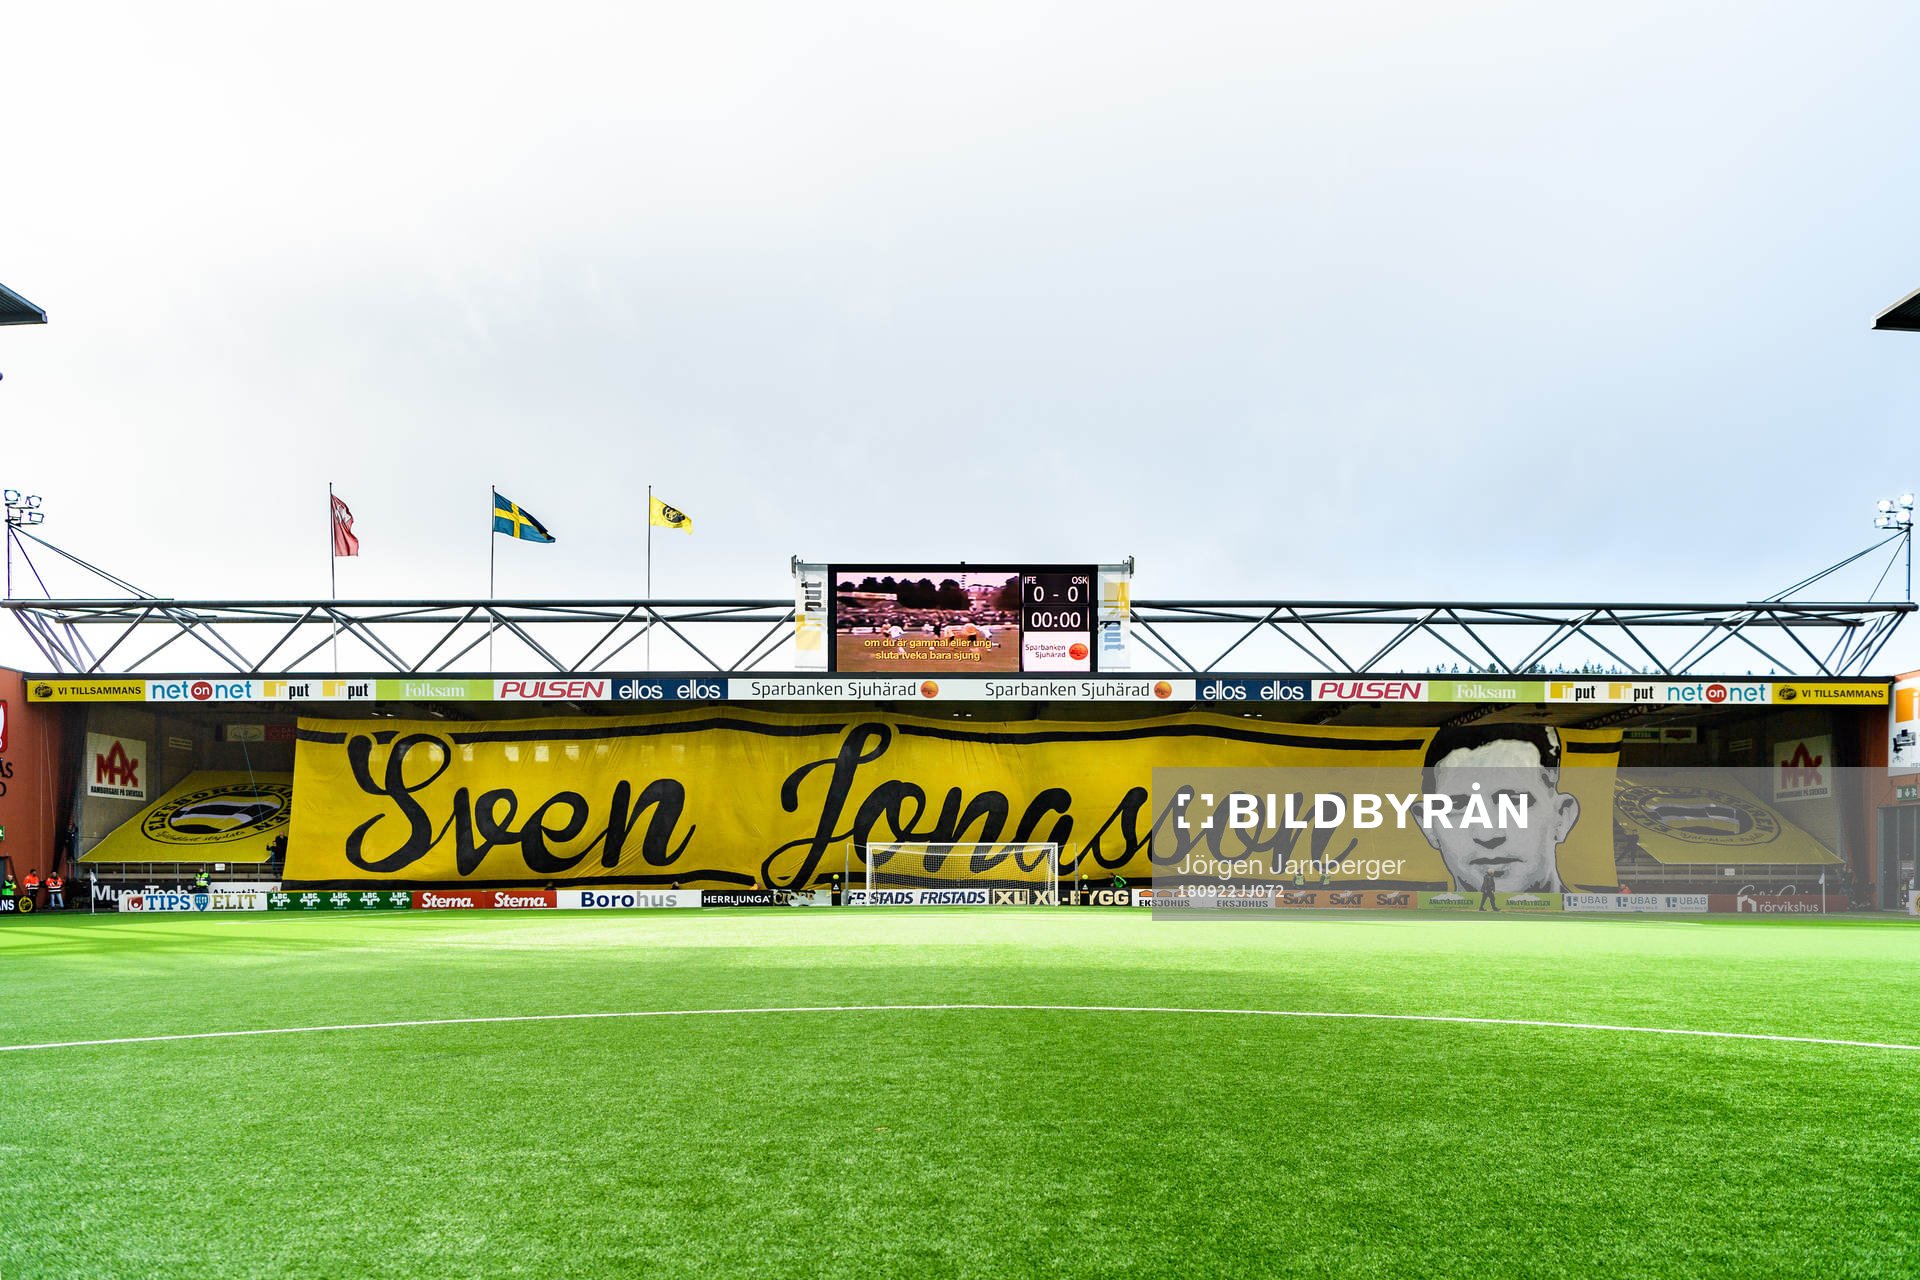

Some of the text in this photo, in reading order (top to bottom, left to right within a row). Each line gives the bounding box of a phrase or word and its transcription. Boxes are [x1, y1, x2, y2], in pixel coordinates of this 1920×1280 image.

[1024, 576, 1088, 585] IFE OSK
[1033, 586, 1045, 602] 0
[1067, 586, 1079, 602] 0
[1031, 611, 1081, 629] 00:00
[864, 637, 992, 650] om du är gammal eller ung
[1025, 643, 1066, 652] Sparbanken
[875, 650, 981, 662] sluta tveka bara sjung
[58, 687, 142, 696] VI TILLSAMMANS
[404, 683, 465, 698] Folksam
[500, 681, 605, 699] PULSEN
[619, 679, 663, 700] ellos
[676, 679, 721, 700] ellos
[751, 681, 916, 700] Sparbanken Sjuhärad
[984, 681, 1150, 700] Sparbanken Sjuhärad
[1202, 680, 1247, 700] ellos
[1260, 680, 1304, 700] ellos
[1318, 682, 1421, 700] PULSEN
[1456, 683, 1516, 699] Folksam
[1801, 689, 1884, 699] VI TILLSAMMANS
[96, 740, 139, 788] MAX
[1781, 742, 1824, 789] MAX
[346, 722, 1358, 890] Sven Jonasson
[145, 894, 191, 910] TIPS
[211, 894, 257, 910] ELIT
[580, 891, 678, 908] Borohus
[703, 895, 769, 906] HERRLJUNGA
[847, 891, 914, 905] FRSTADS
[919, 891, 986, 905] FRISTADS
[996, 891, 1027, 905] XL
[1580, 896, 1608, 904] UBAB
[1630, 896, 1658, 904] UBAB
[1679, 896, 1707, 904] UBAB
[1759, 901, 1820, 913] rörvikshus
